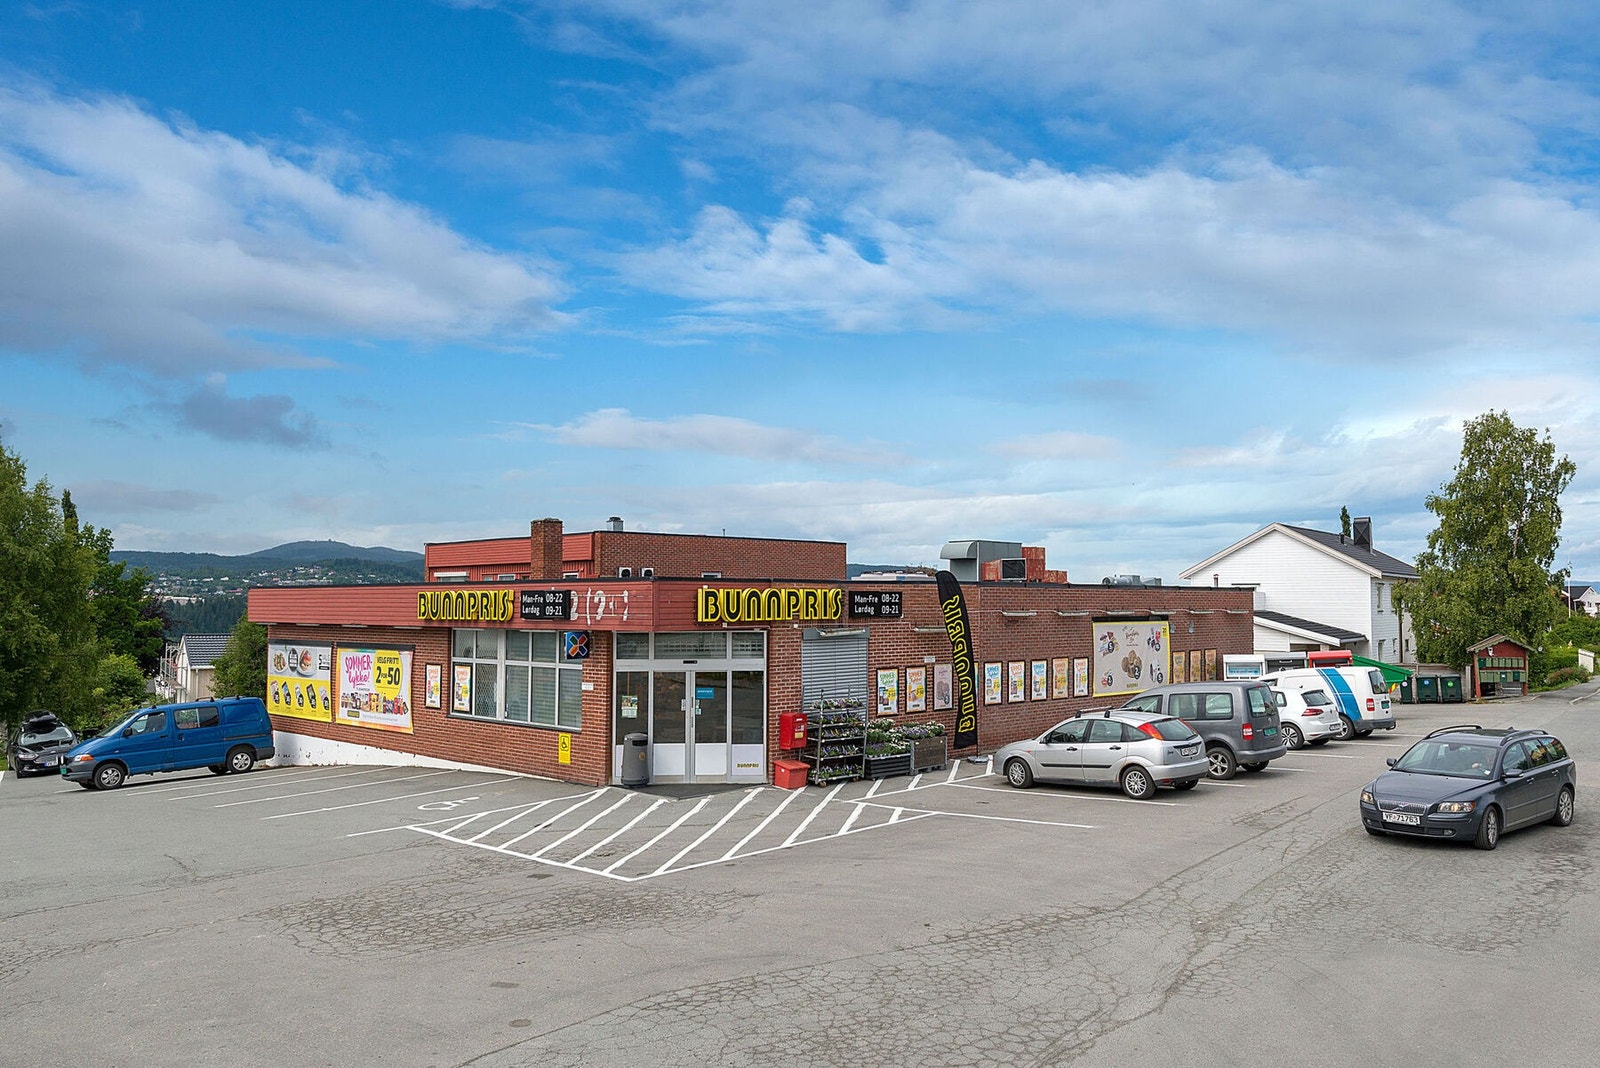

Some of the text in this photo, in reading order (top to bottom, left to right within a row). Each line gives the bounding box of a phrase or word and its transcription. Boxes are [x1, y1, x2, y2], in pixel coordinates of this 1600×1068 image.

[417, 589, 514, 621] BUNNPRIS
[522, 593, 563, 603] Man-Fre 08-22
[697, 588, 842, 622] BUNNPRIS
[854, 593, 900, 603] Man-Fre 08-22
[545, 605, 563, 615] 09-21
[881, 605, 900, 614] 09-21
[942, 594, 975, 733] BUNNPRIS
[375, 665, 382, 684] 2
[387, 666, 401, 686] 50
